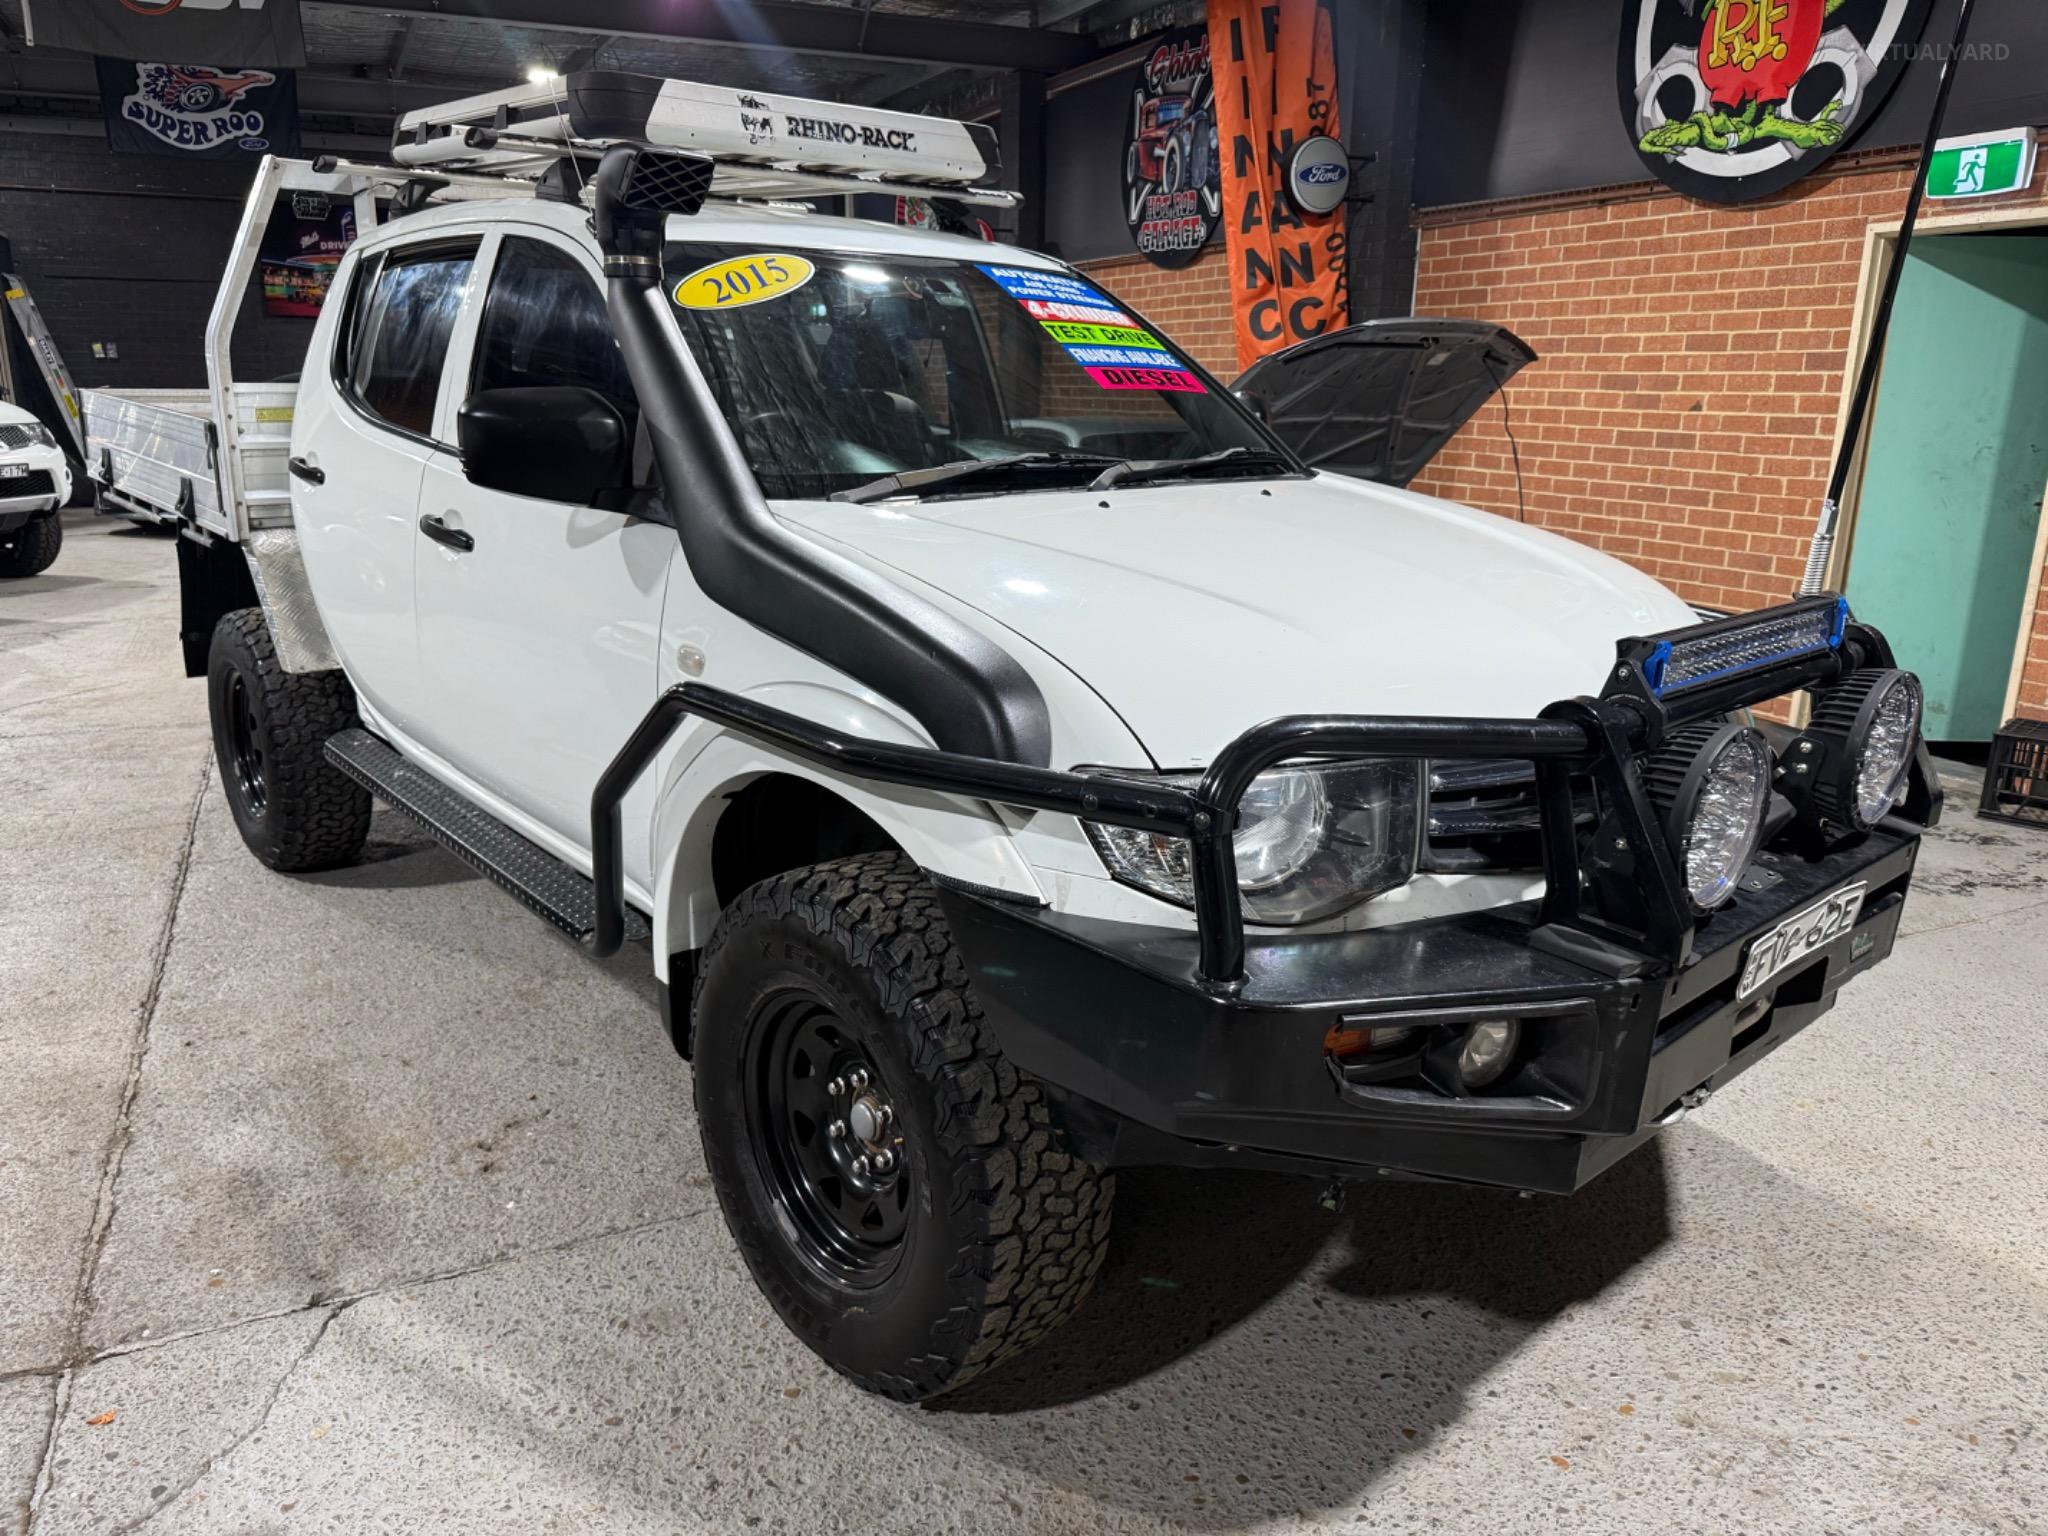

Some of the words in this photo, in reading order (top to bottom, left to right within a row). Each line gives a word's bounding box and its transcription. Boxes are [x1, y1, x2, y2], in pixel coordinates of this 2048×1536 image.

[127, 101, 213, 146] SUPER
[212, 112, 261, 138] ROO
[786, 115, 917, 152] RHINO-RACK
[1261, 5, 1328, 340] FINANC
[1308, 163, 1341, 183] Ford
[1146, 194, 1171, 220] HOT
[1172, 190, 1197, 218] ROD
[320, 241, 351, 251] DRIV
[1141, 214, 1202, 253] GARAGE
[702, 258, 789, 304] 2015
[1008, 286, 1056, 298] POWER
[1046, 325, 1099, 341] TEST
[1101, 329, 1158, 346] DRIVE
[1102, 369, 1197, 389] DIESEL
